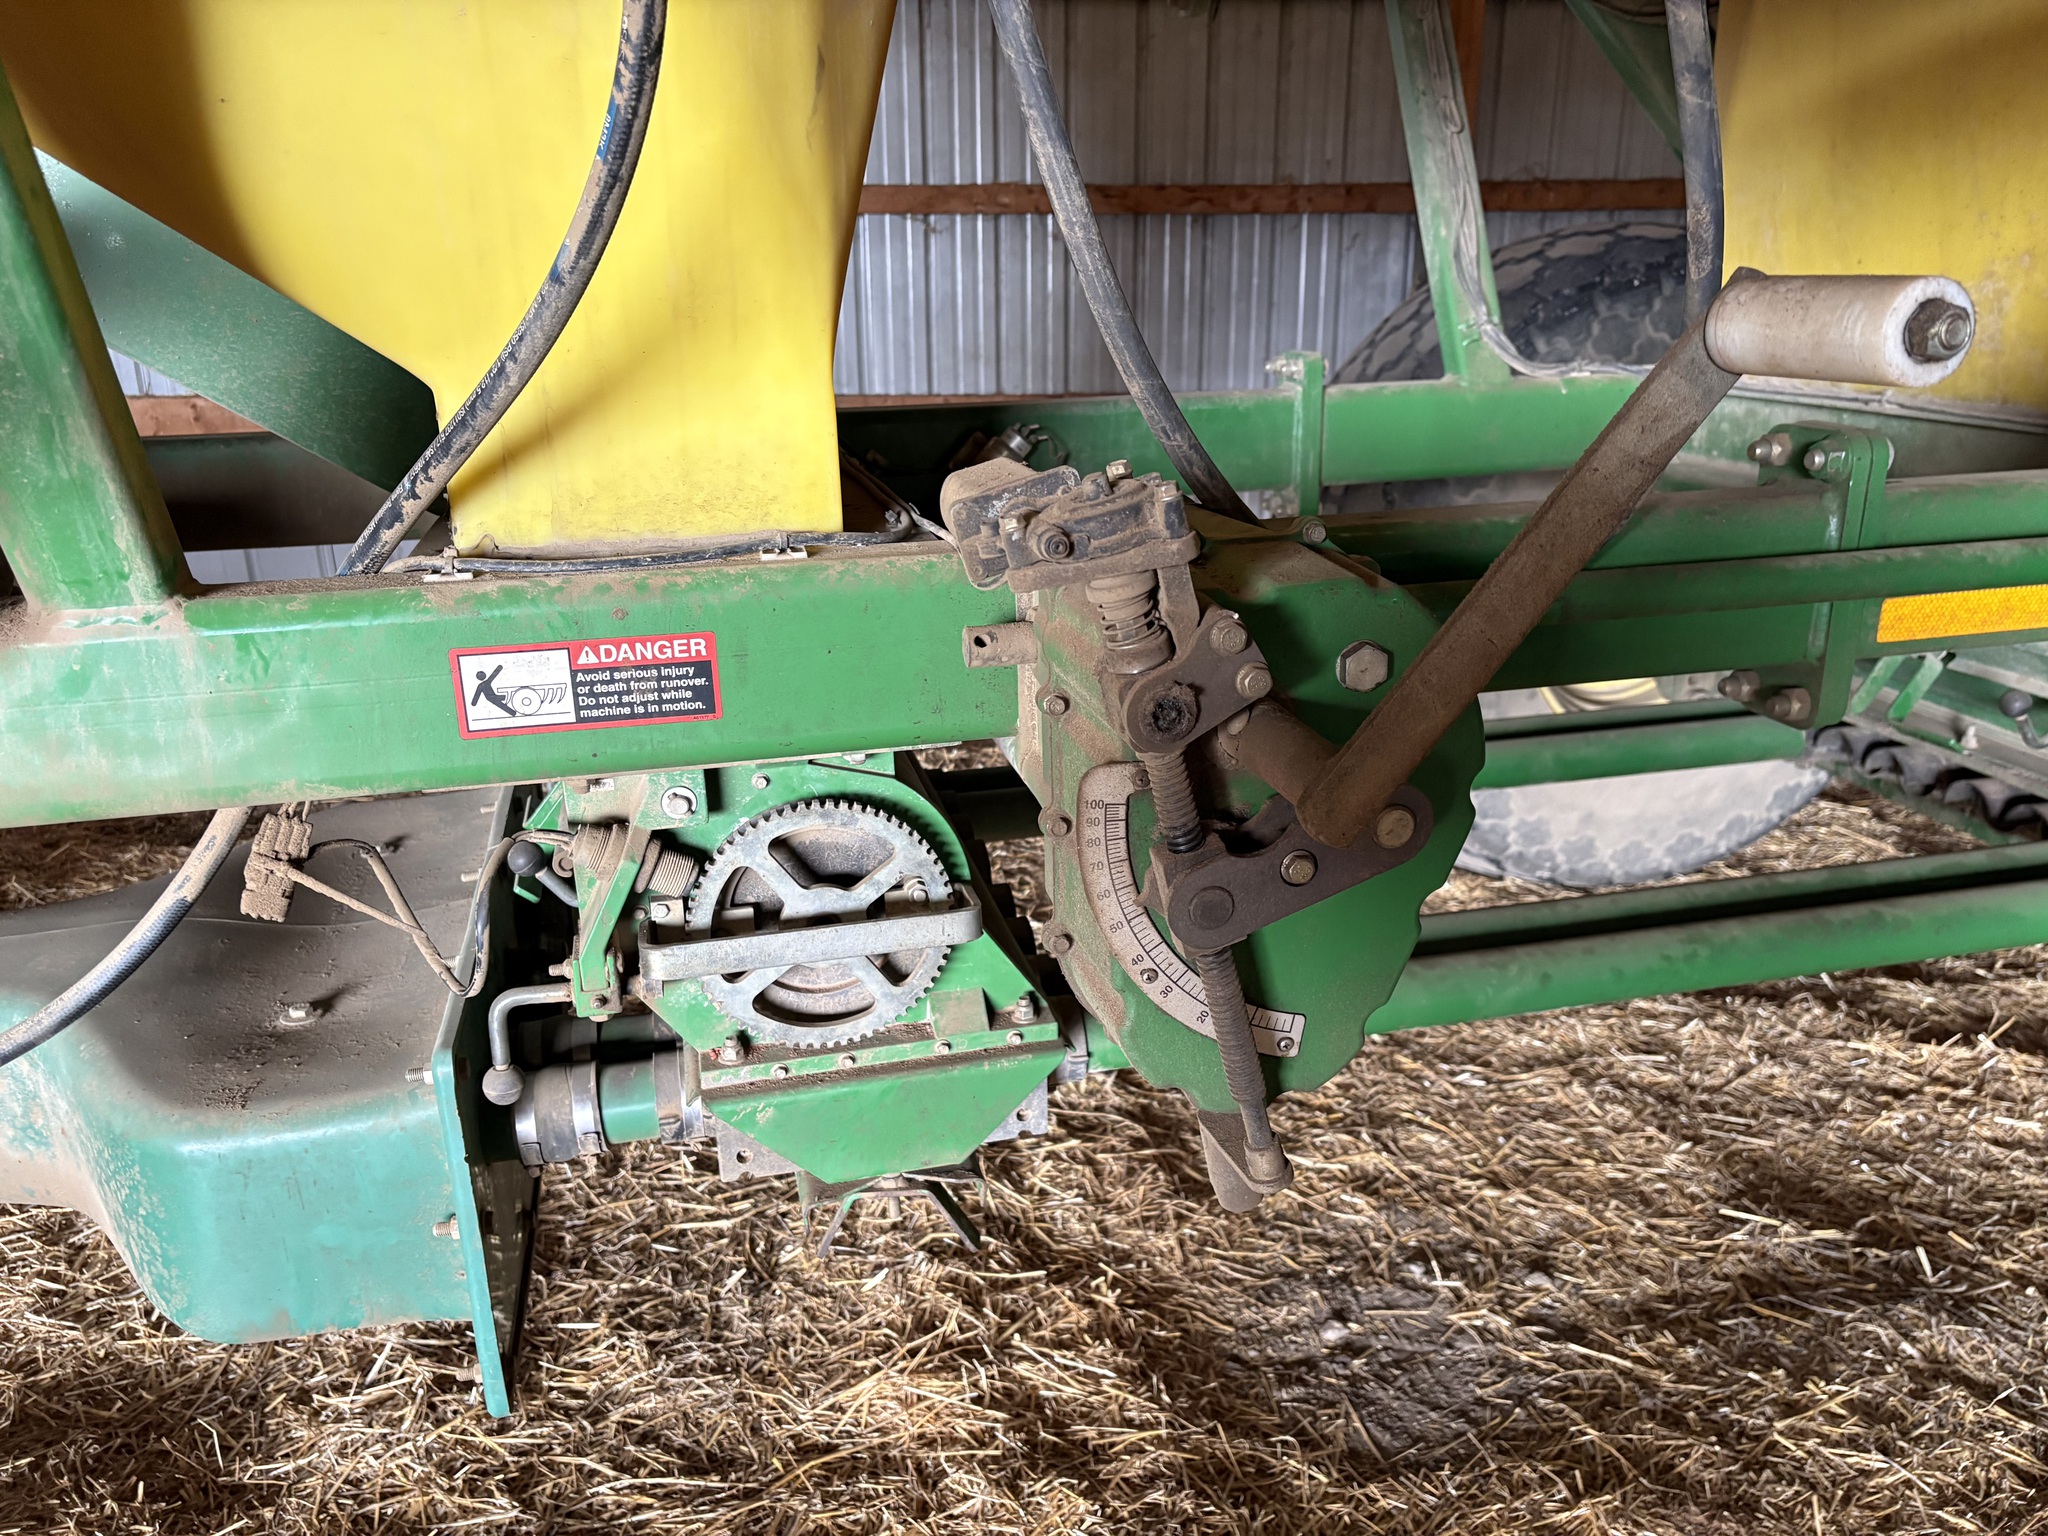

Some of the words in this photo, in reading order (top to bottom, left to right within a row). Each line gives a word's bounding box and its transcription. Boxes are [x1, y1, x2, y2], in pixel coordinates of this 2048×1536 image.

[599, 638, 707, 663] DANGER
[576, 671, 610, 682] Avoid
[613, 668, 658, 680] serious
[661, 666, 695, 677] injury
[577, 684, 590, 694] or
[593, 682, 627, 693] death
[630, 679, 658, 690] from
[661, 677, 709, 688] runover.
[579, 696, 596, 706] Do
[599, 694, 619, 704] not
[622, 691, 659, 705] adjust
[661, 689, 693, 700] while
[580, 705, 631, 718] machine
[634, 704, 645, 714] is
[648, 703, 659, 713] in
[662, 701, 706, 712] motion.
[1085, 799, 1105, 810] 100
[1086, 817, 1100, 827] 90
[1086, 837, 1101, 848] 80
[1090, 861, 1104, 872] 70
[1097, 889, 1111, 901] 60
[1110, 921, 1124, 933] 50
[1131, 954, 1144, 966] 40
[1160, 985, 1173, 998] 30
[1196, 1010, 1210, 1024] 20
